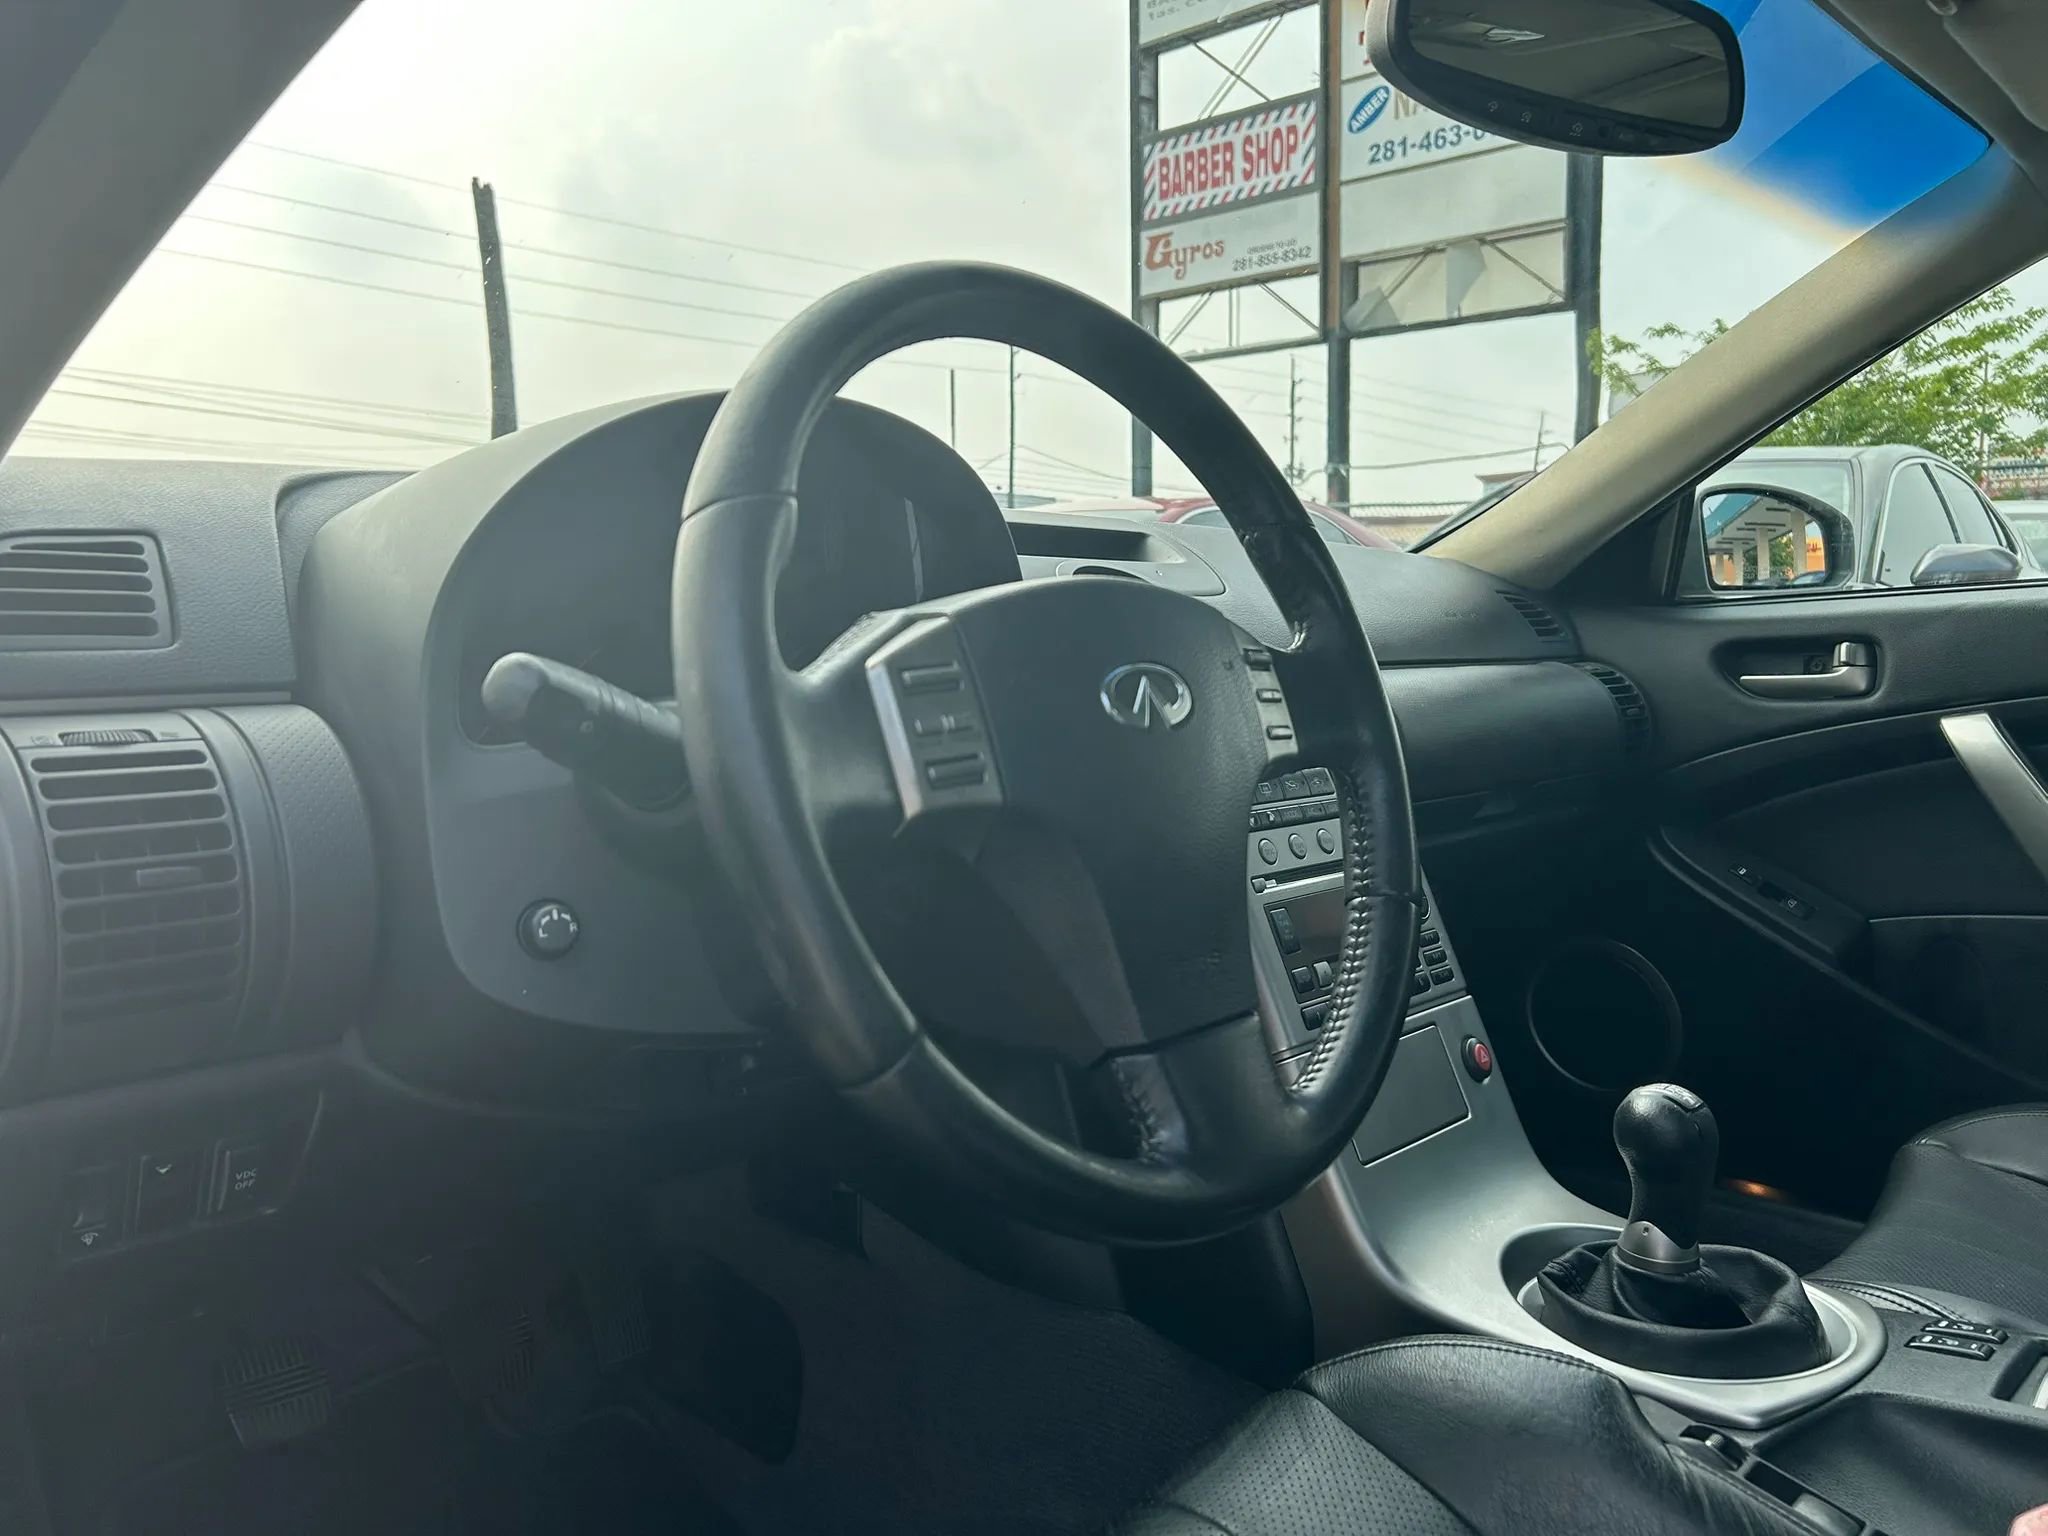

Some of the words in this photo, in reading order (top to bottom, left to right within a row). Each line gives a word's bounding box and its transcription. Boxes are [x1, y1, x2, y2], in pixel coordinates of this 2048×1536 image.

[1350, 87, 1389, 131] AMBER
[1159, 140, 1235, 201] BARBER
[1242, 124, 1299, 182] SHOP
[1367, 124, 1487, 165] 281-463-0
[1144, 231, 1225, 281] Gyros
[234, 1178, 256, 1190] OFF
[235, 1168, 257, 1180] VDC
